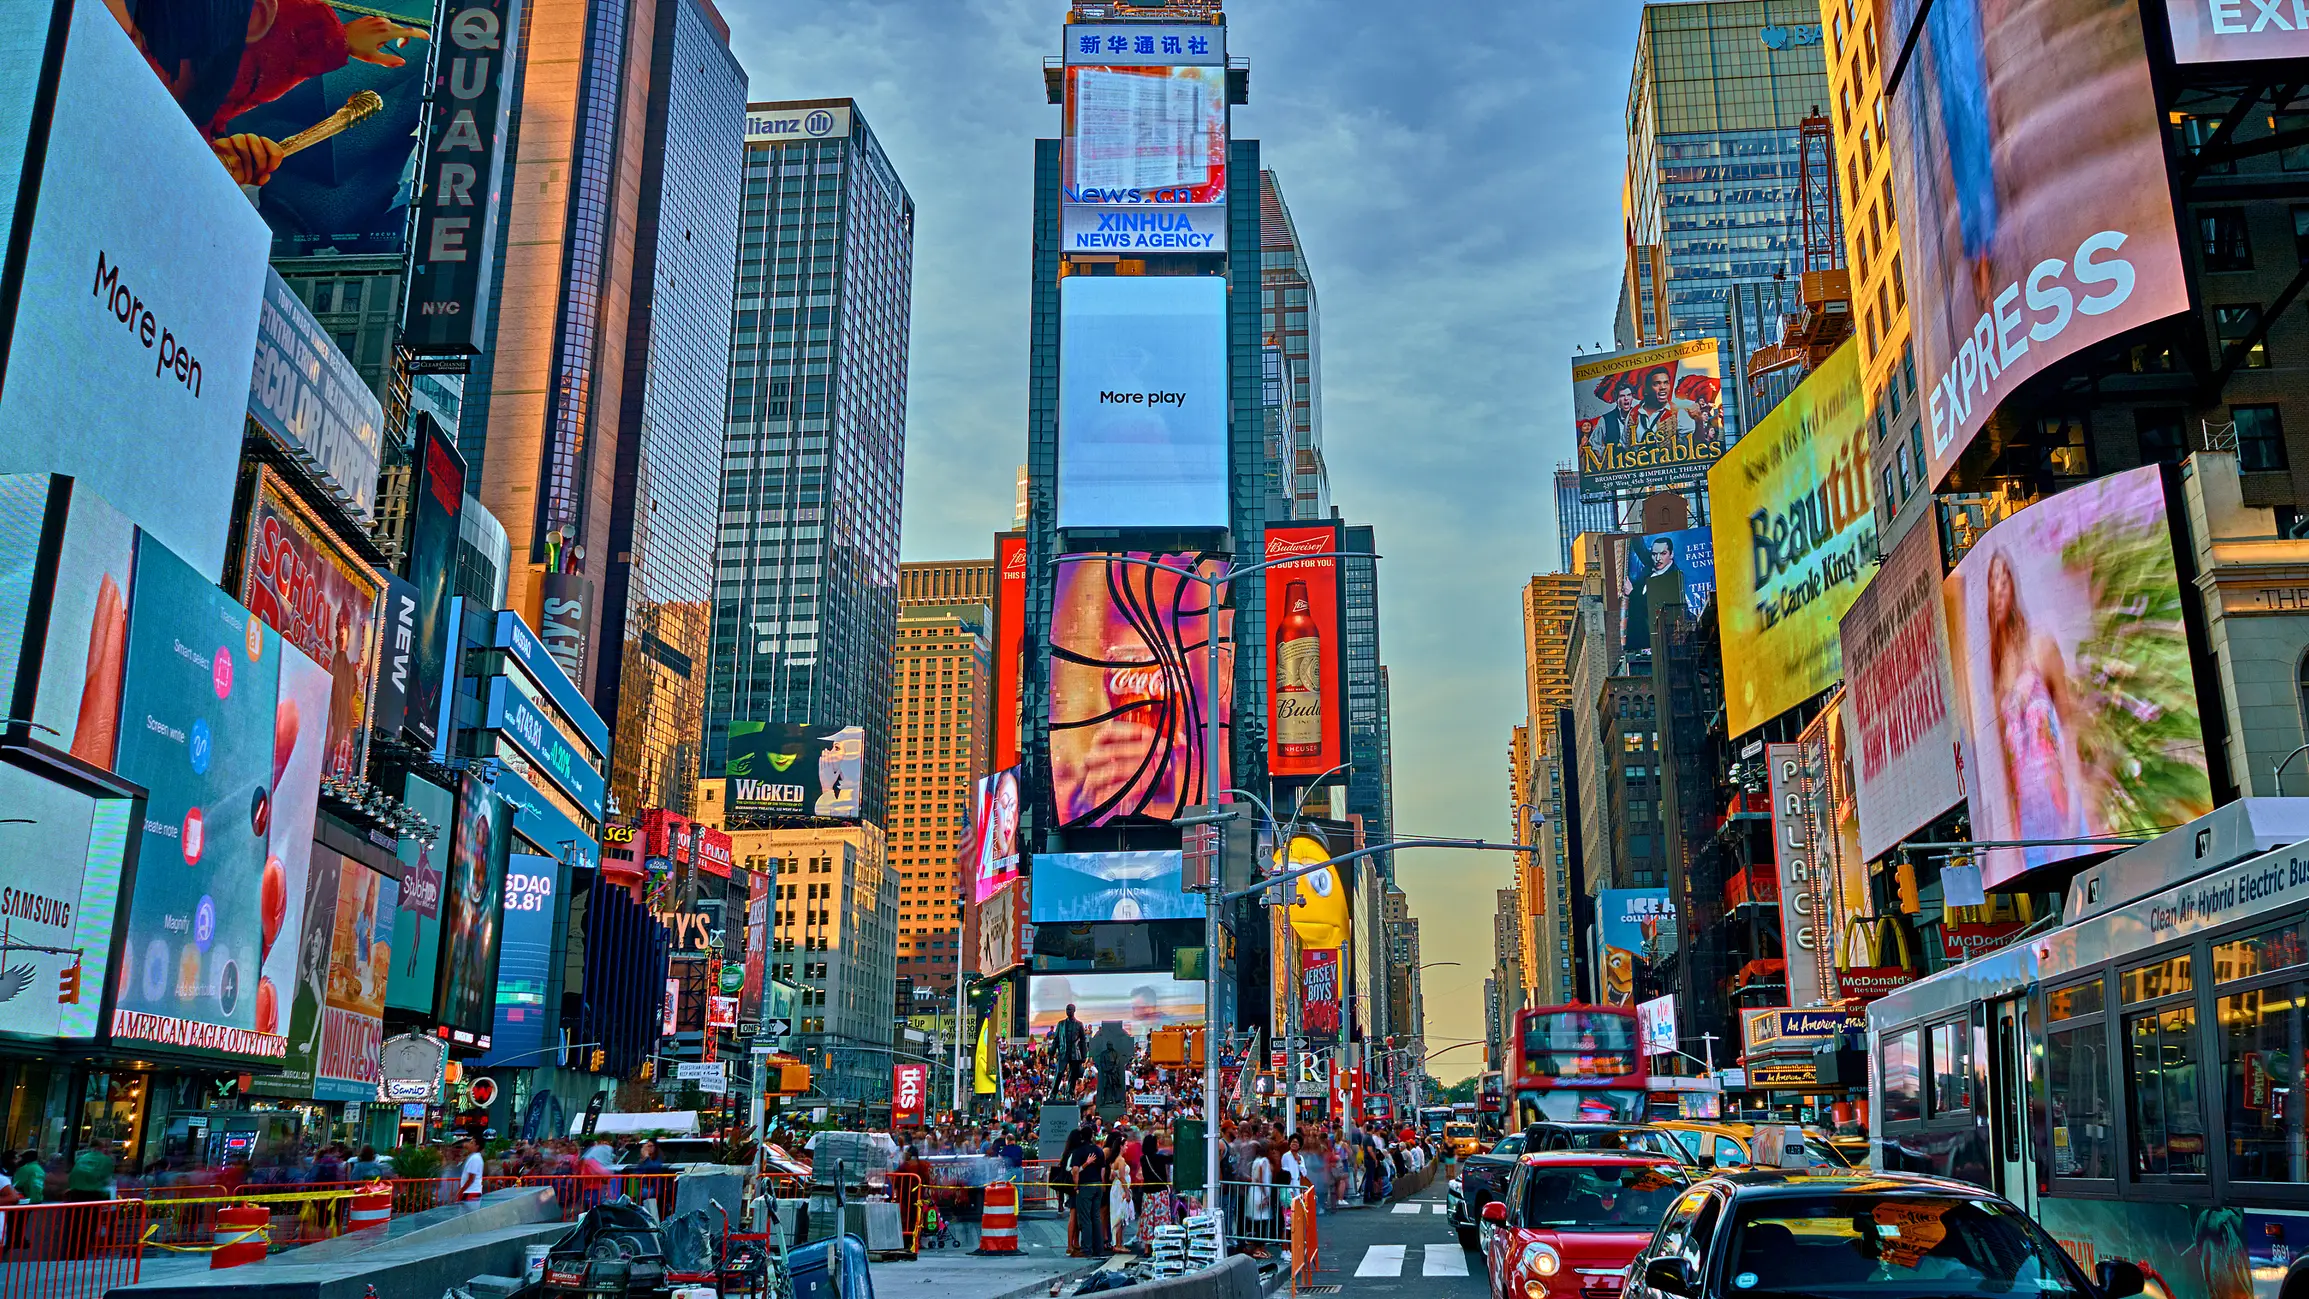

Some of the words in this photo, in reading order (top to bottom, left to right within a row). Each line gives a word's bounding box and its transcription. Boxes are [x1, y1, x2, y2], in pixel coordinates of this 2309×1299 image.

[1080, 35, 1209, 55] 新华通讯社
[428, 7, 500, 262] QUARE
[745, 117, 800, 135] lianz
[1097, 213, 1193, 232] XINHUA
[1076, 233, 1131, 247] NEWS
[1135, 233, 1214, 247] AGENCY
[422, 301, 461, 315] NYC
[92, 249, 156, 349] More
[157, 326, 202, 399] pen
[1928, 230, 2135, 460] EXPRESS
[1575, 367, 1601, 379] FINAL
[1644, 351, 1672, 363] DON'T
[1674, 345, 1691, 358] MIZ
[1691, 340, 1714, 353] OUT!
[1100, 391, 1144, 404] More
[1148, 390, 1186, 407] play
[262, 346, 323, 461] COLOR
[320, 410, 377, 523] PURPLE
[1630, 425, 1665, 447] Les
[1582, 433, 1722, 474] Misérables
[1594, 472, 1637, 483] BROADWAY'S
[1645, 468, 1678, 477] IMPERIAL
[1645, 475, 1663, 483] Street
[1269, 541, 1322, 554] Budweiser
[1687, 543, 1706, 552] LET
[1277, 560, 1300, 568] BUD'S
[1316, 559, 1334, 567] YOU.
[257, 515, 333, 644] SCHOOL
[1003, 572, 1020, 580] THIS
[1780, 566, 1823, 611] Carole
[1823, 541, 1856, 592] King
[2260, 588, 2309, 609] THE
[293, 619, 307, 646] OF
[174, 637, 194, 662] Smart
[193, 647, 210, 671] select
[391, 594, 416, 694] NEW
[1277, 698, 1321, 719] Bud
[146, 714, 170, 737] Screen
[169, 722, 186, 744] write
[1284, 744, 1317, 752] NHEUSER
[735, 779, 805, 803] WICKED
[163, 822, 178, 839] note
[706, 843, 730, 864] PLAZA
[1782, 758, 1816, 951] PALACE
[403, 874, 437, 902] StubHub
[1107, 887, 1149, 896] HYUNDAI
[2150, 905, 2178, 933] Clean
[2179, 896, 2196, 925] Air
[2197, 879, 2235, 922] Hybrid
[2238, 863, 2285, 904] Electric
[1, 886, 71, 929] SAMSUNG
[1626, 898, 1660, 914] ICE
[164, 913, 191, 935] Magnify
[1303, 963, 1337, 986] JERSEY
[1842, 975, 1913, 987] McDonald's
[1307, 981, 1332, 1002] BOYS
[743, 1024, 759, 1032] ONE
[914, 1019, 925, 1027] UP
[1786, 1016, 1799, 1032] An
[1800, 1014, 1844, 1034] American
[113, 1010, 191, 1046] AMERICAN
[190, 1022, 226, 1050] EAGLE
[227, 1027, 289, 1058] OUTFITTERS
[319, 1007, 382, 1084] WAITRESS
[1766, 1073, 1775, 1082] An
[1775, 1072, 1802, 1083] American
[392, 1084, 426, 1095] Sanrio
[900, 1068, 921, 1109] tkts
[2272, 1243, 2290, 1260] 6691
